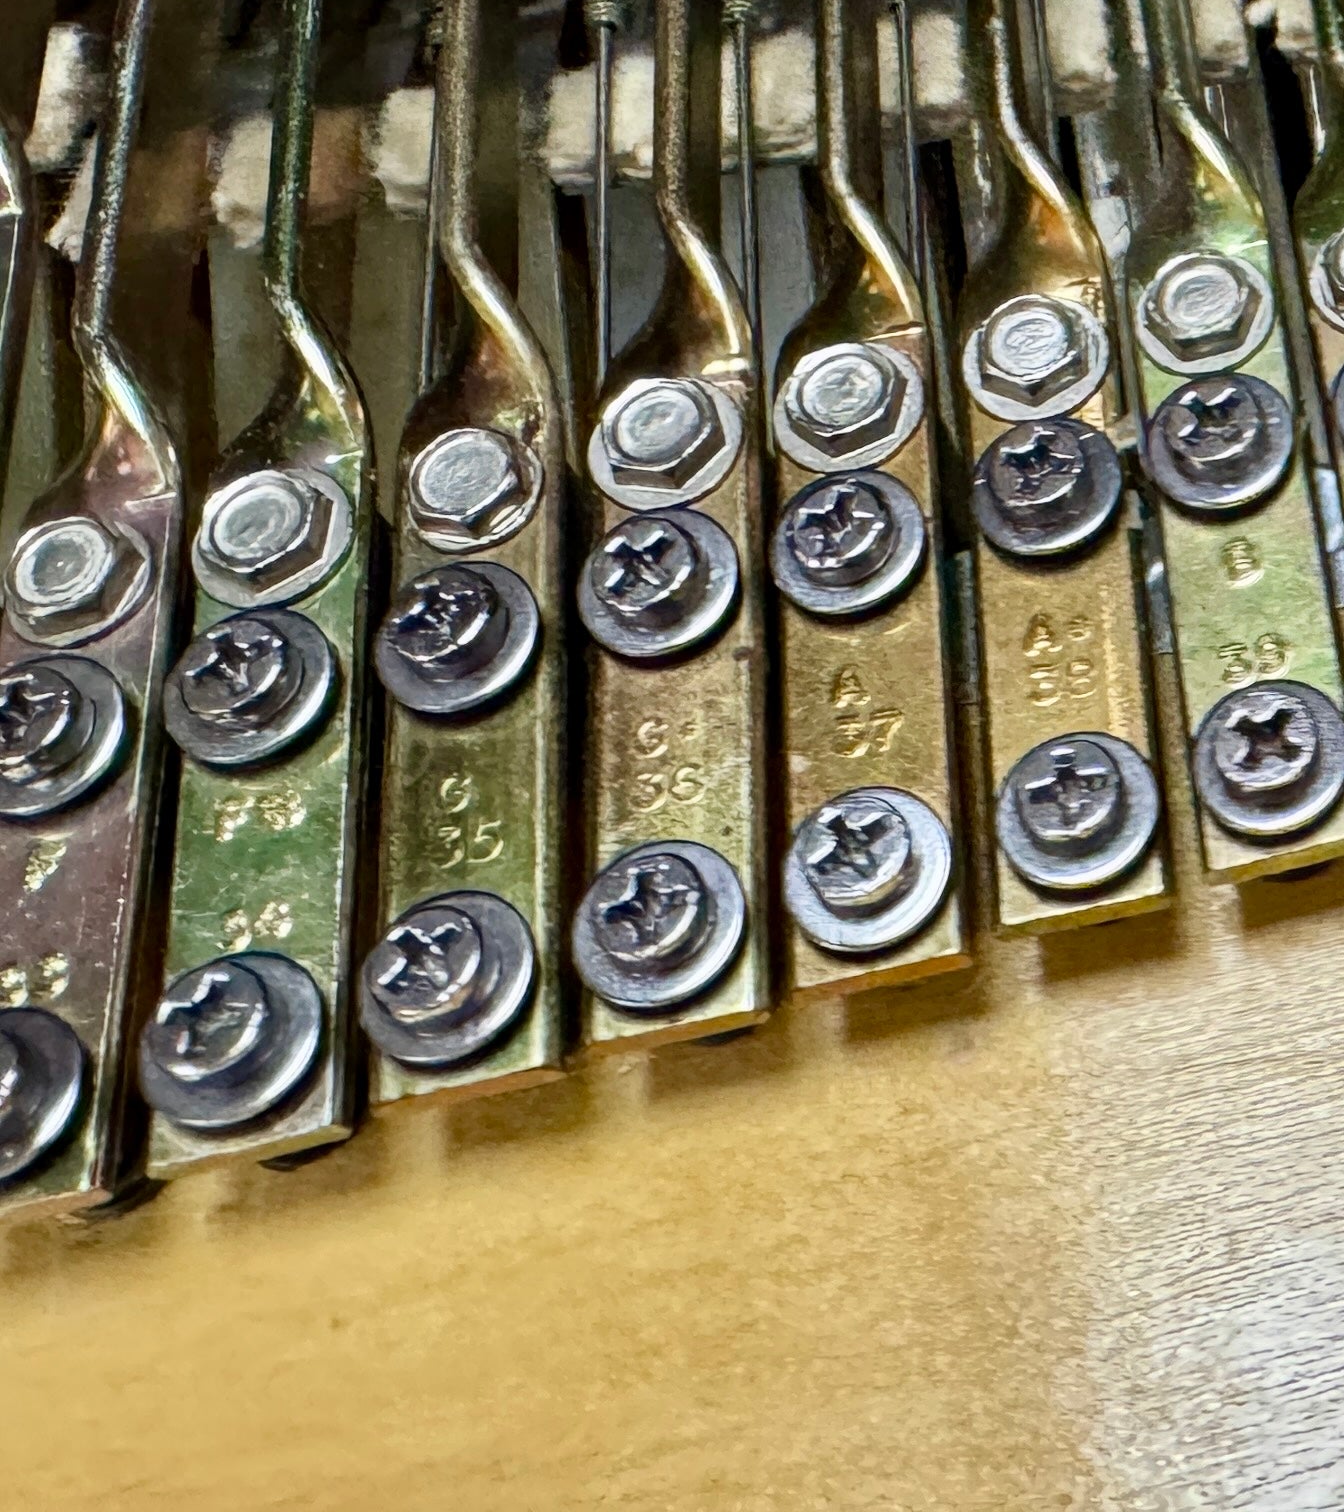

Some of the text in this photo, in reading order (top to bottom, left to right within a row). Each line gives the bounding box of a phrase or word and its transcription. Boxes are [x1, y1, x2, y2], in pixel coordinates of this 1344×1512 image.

[834, 664, 872, 708] A
[832, 707, 903, 758] 37
[440, 774, 474, 815] G
[434, 819, 505, 870] 35
